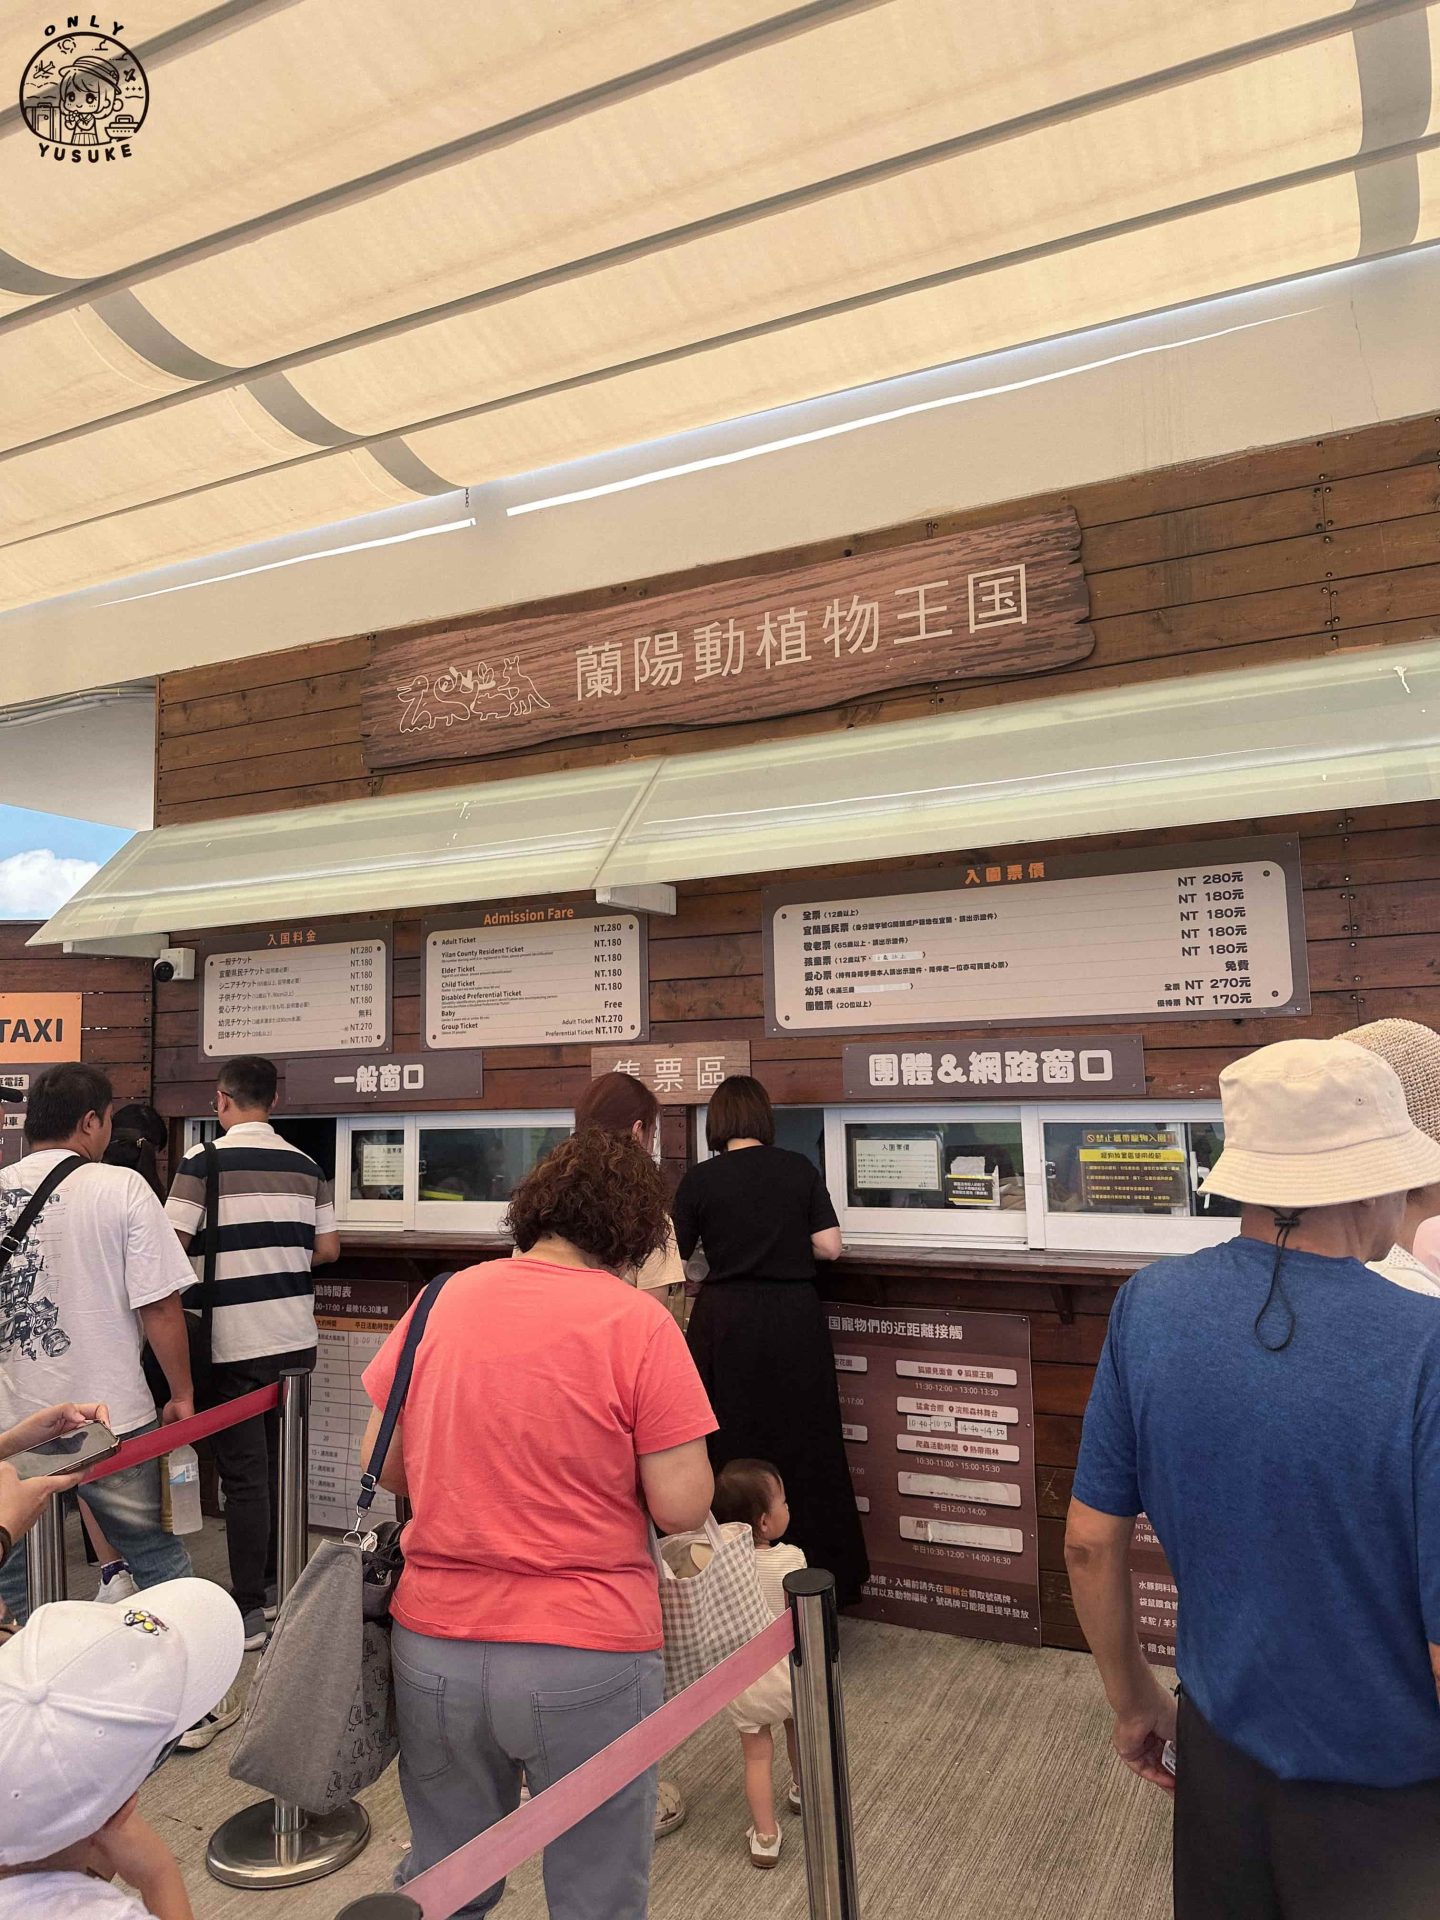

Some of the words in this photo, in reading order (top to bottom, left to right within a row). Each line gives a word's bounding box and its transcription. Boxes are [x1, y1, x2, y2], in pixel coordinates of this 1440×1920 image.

[575, 563, 1028, 701] 蘭陽動植物王国
[964, 862, 1045, 885] 入園票價
[1178, 876, 1196, 887] NT
[1203, 871, 1244, 885] 280元
[1179, 894, 1197, 904] NT
[1205, 889, 1244, 902] 180元
[483, 909, 546, 926] Admission
[547, 907, 574, 919] Fare
[802, 911, 821, 920] 全票
[1180, 911, 1199, 921] NT
[1207, 907, 1246, 919] 180元
[594, 923, 622, 933] NT.280
[1181, 929, 1200, 939] NT
[1208, 925, 1247, 937] 180元
[267, 929, 317, 946] 入国料金
[441, 937, 457, 946] Adult
[459, 936, 476, 944] Ticket
[594, 938, 622, 948] NT.180
[803, 941, 831, 951] 敬老票
[350, 946, 373, 955] NT.280
[441, 951, 456, 959] Yilan
[457, 949, 478, 958] County
[478, 947, 504, 955] Resident
[505, 946, 524, 954] Ticket
[1182, 946, 1200, 957] NT
[1209, 942, 1248, 955] 180元
[350, 958, 373, 967] NT.180
[594, 953, 622, 963] NT.180
[441, 966, 456, 974] Elder
[457, 965, 475, 973] Ticket
[1225, 960, 1249, 972] 免費
[350, 971, 373, 980] NT.180
[594, 968, 622, 978] NT.180
[804, 971, 832, 981] 愛心票
[350, 983, 373, 992] NT.180
[457, 979, 475, 987] Ticket
[594, 982, 622, 992] NT.180
[1185, 980, 1204, 990] NT
[1210, 977, 1251, 988] 270元
[467, 991, 503, 1000] Preferential
[805, 986, 823, 996] 幼兒
[350, 996, 373, 1005] NT.180
[1186, 996, 1204, 1006] NT
[1213, 993, 1252, 1005] 170元
[604, 1001, 623, 1009] Free
[358, 1009, 372, 1018] 無料
[441, 1010, 456, 1018] Baby
[595, 1014, 623, 1024] NT.270
[0, 1018, 63, 1043] TAXI
[350, 1022, 373, 1032] NT.270
[441, 1023, 459, 1031] Group
[545, 1029, 576, 1037] Preferential
[595, 1025, 623, 1035] NT.170
[350, 1035, 373, 1044] NT.170
[333, 1063, 425, 1093] 一般窗口
[313, 1285, 352, 1298] 動時間表
[860, 1585, 1030, 1620] 品質以及動物福祉，號碼牌可能限量提早發放
